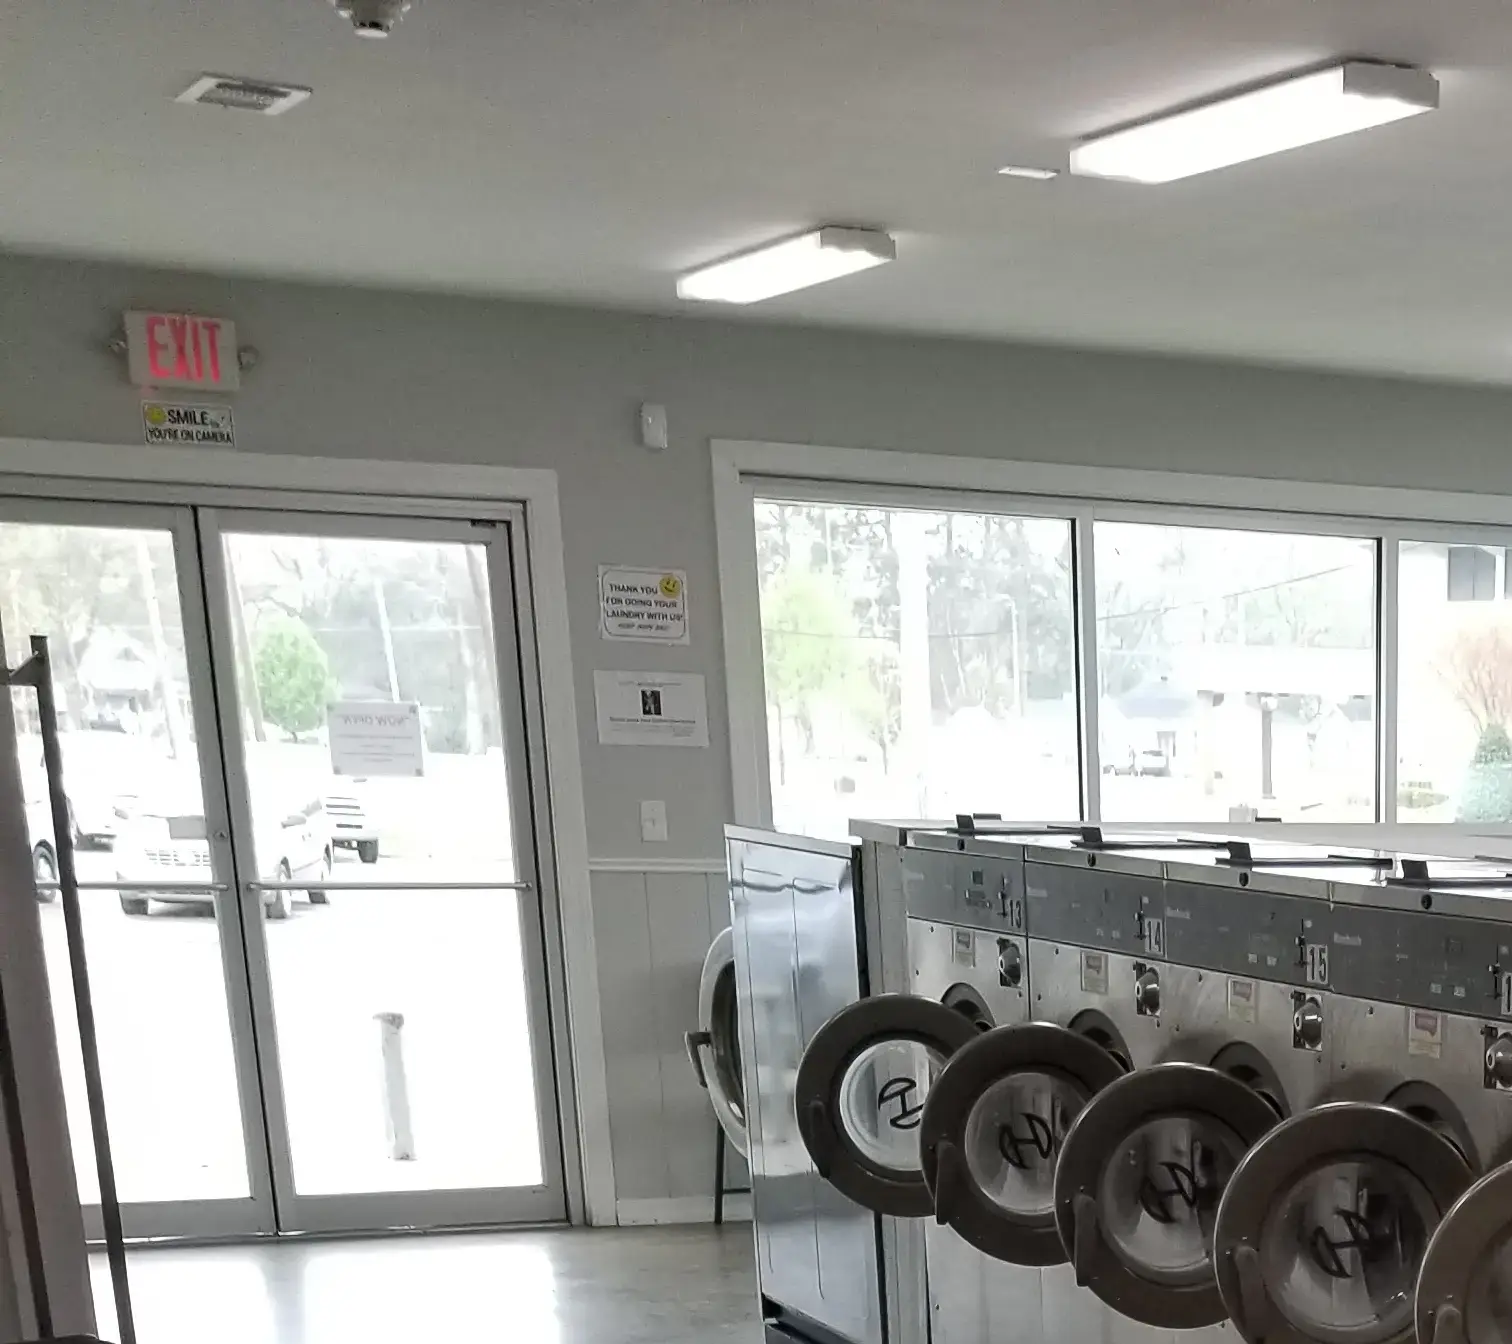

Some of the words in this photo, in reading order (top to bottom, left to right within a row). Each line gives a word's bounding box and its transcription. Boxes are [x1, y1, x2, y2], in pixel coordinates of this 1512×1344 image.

[146, 315, 221, 383] EXIT
[167, 409, 209, 425] SMILE
[609, 583, 638, 593] THANK
[640, 586, 658, 595] YOU
[647, 612, 668, 621] WITH
[1010, 899, 1022, 929] 13
[1146, 920, 1161, 952] 14
[1309, 946, 1327, 983] 15
